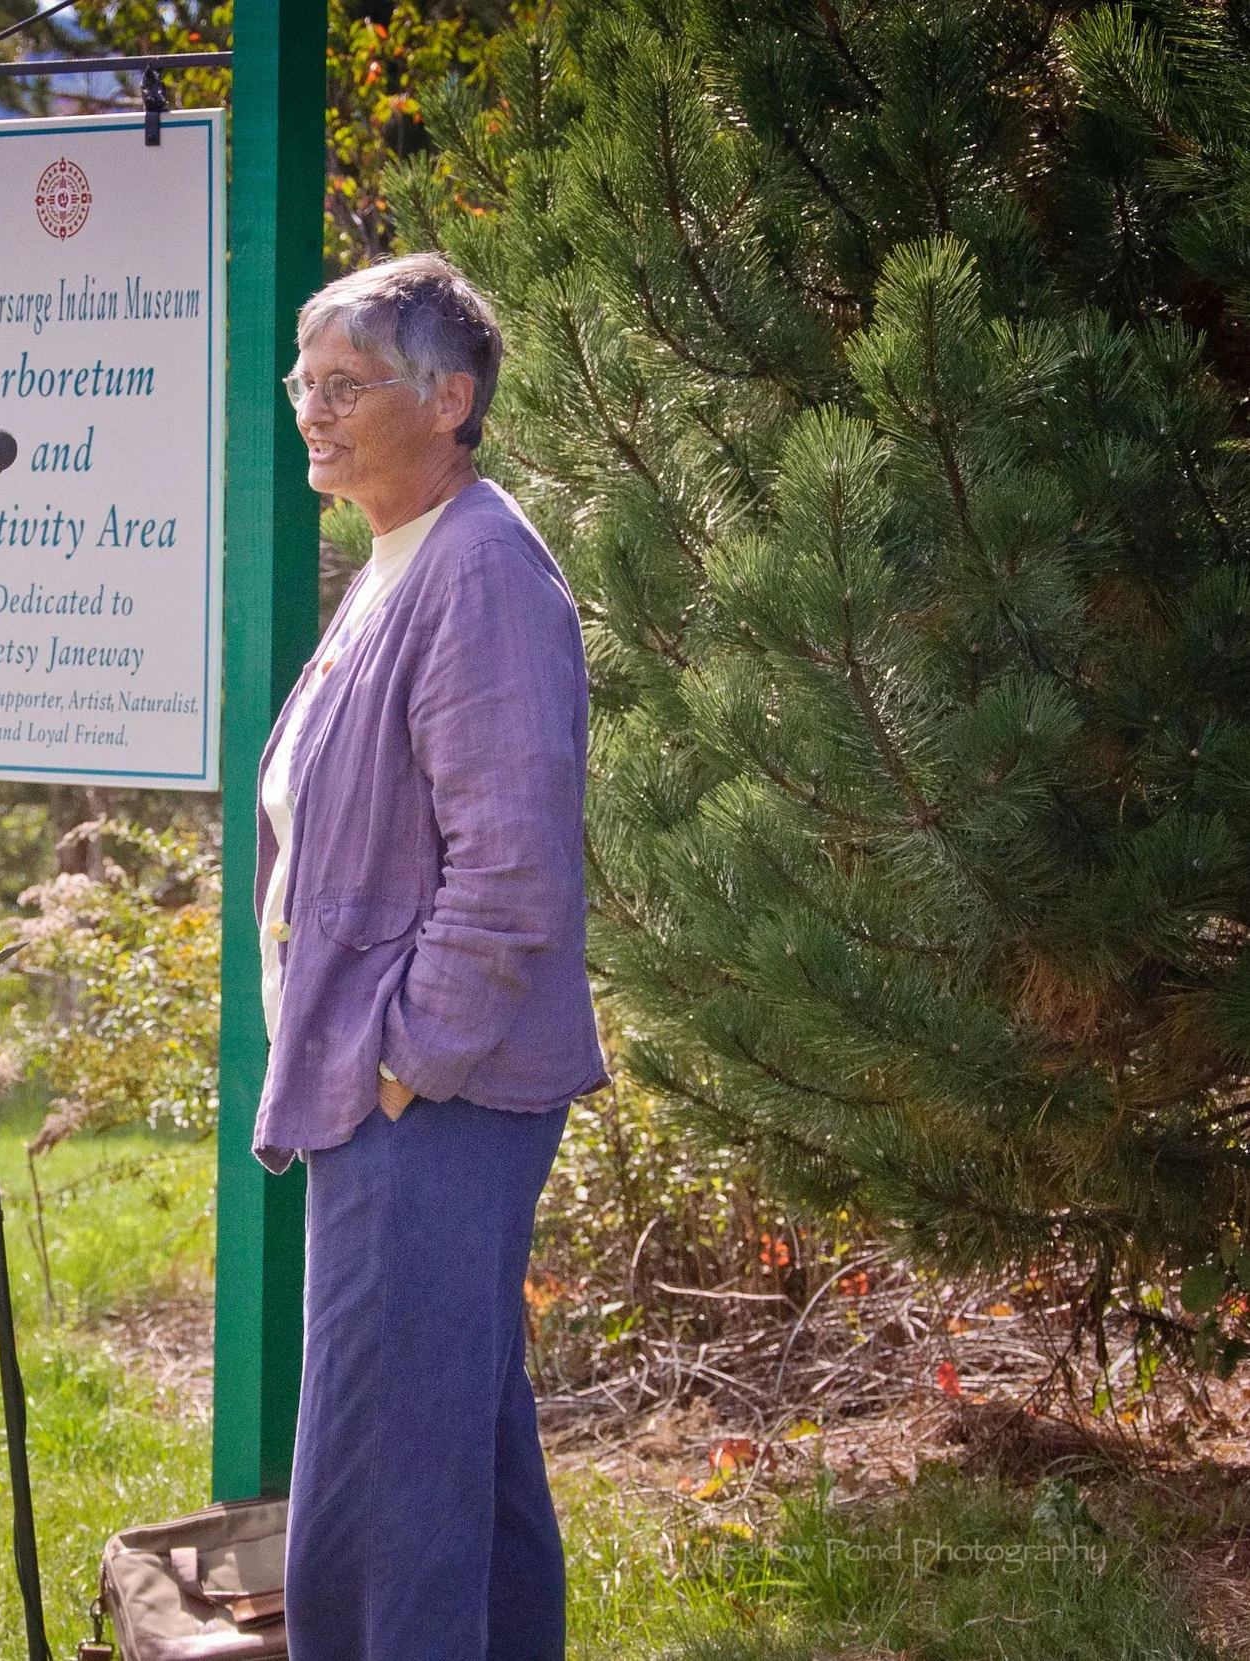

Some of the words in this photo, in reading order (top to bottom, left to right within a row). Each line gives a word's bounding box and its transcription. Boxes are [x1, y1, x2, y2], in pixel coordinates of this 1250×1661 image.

[57, 274, 118, 322] Indian
[123, 276, 201, 320] Museum
[31, 425, 94, 473] and
[96, 504, 177, 548] Area
[112, 592, 134, 616] to
[46, 636, 145, 676] Janeway
[67, 690, 115, 713] Artist,
[118, 691, 199, 716] Naturalist,
[27, 721, 70, 748] Loyal
[74, 723, 128, 747] Friend.
